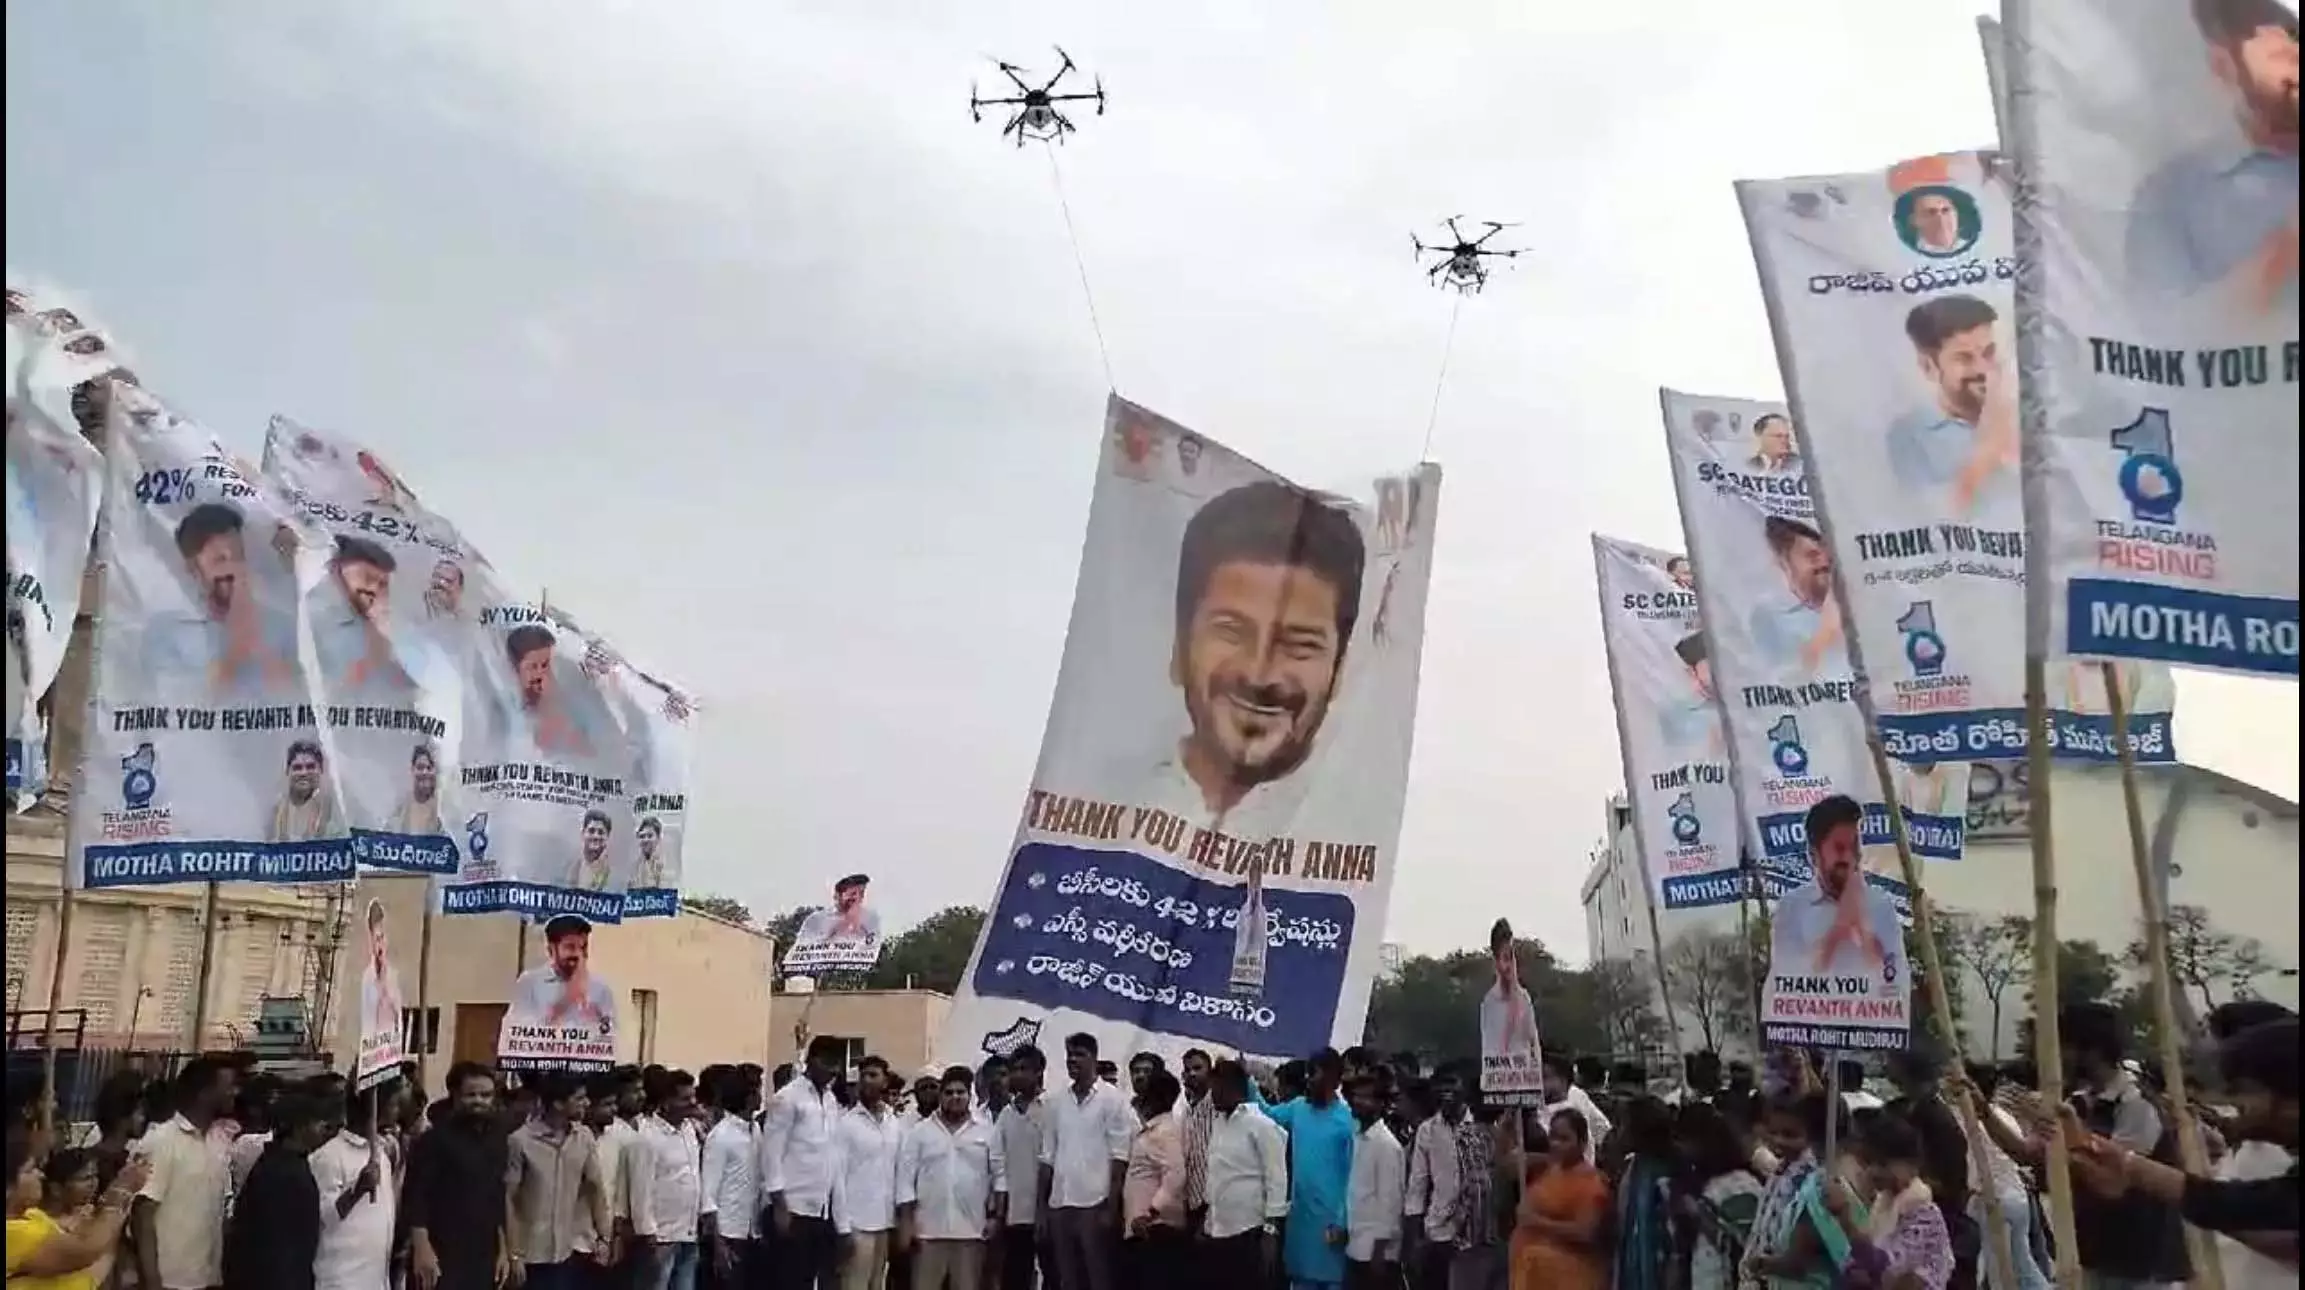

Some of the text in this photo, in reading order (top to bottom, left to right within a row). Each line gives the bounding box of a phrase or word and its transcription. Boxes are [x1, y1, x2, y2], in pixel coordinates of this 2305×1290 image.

[2089, 337, 2185, 387] THANK
[2196, 346, 2268, 388] YOU
[135, 467, 196, 504] 42%
[1855, 527, 1935, 560] THANK
[1938, 524, 1976, 552] YOU
[2096, 520, 2217, 551] TELANGANA
[2098, 540, 2216, 580] RISING
[1623, 594, 1649, 610] SC
[2091, 601, 2237, 652] MOTHA
[113, 709, 168, 731] THANK
[176, 708, 216, 730] YOU
[503, 763, 528, 781] YOU
[1694, 764, 1725, 784] YOU
[1030, 789, 1126, 839] THANK
[1130, 807, 1187, 852] YOU
[1300, 840, 1376, 882] ANNA
[93, 851, 351, 878] MOTHA ROHIT MUDIRAJ
[548, 892, 620, 917] MUDIRAJ
[1774, 975, 1830, 995] THANK
[1836, 976, 1869, 994] YOU
[1773, 997, 1904, 1020] REVANTH ANNA
[511, 1026, 589, 1041] THANK YOU
[1766, 1026, 1903, 1050] MOTHA ROHIT MUDIRAJ
[508, 1041, 615, 1056] REVANTH ANNA
